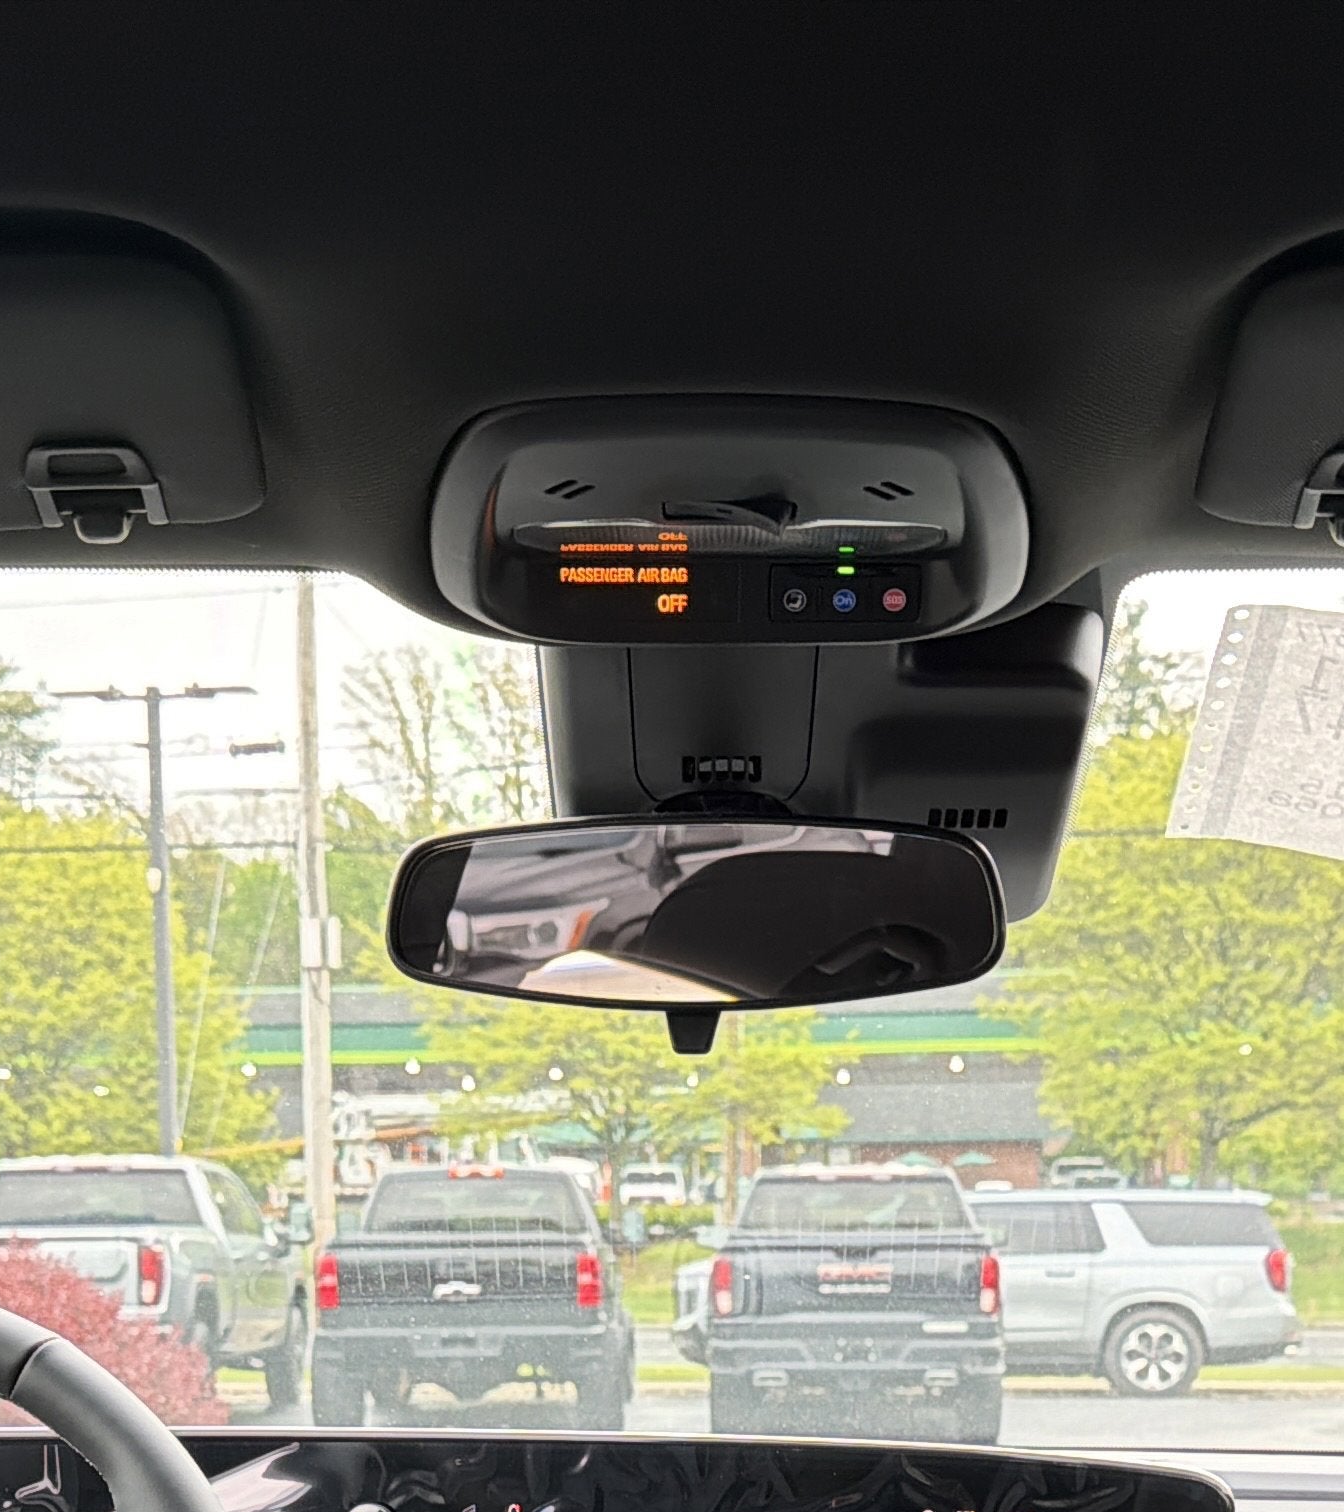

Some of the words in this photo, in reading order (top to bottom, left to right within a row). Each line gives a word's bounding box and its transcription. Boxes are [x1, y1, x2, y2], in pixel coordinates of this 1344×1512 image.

[560, 567, 635, 583] PASSENGER
[638, 567, 660, 583] AIR
[661, 567, 688, 583] BAG
[657, 594, 688, 613] OFF
[886, 594, 903, 604] SOS
